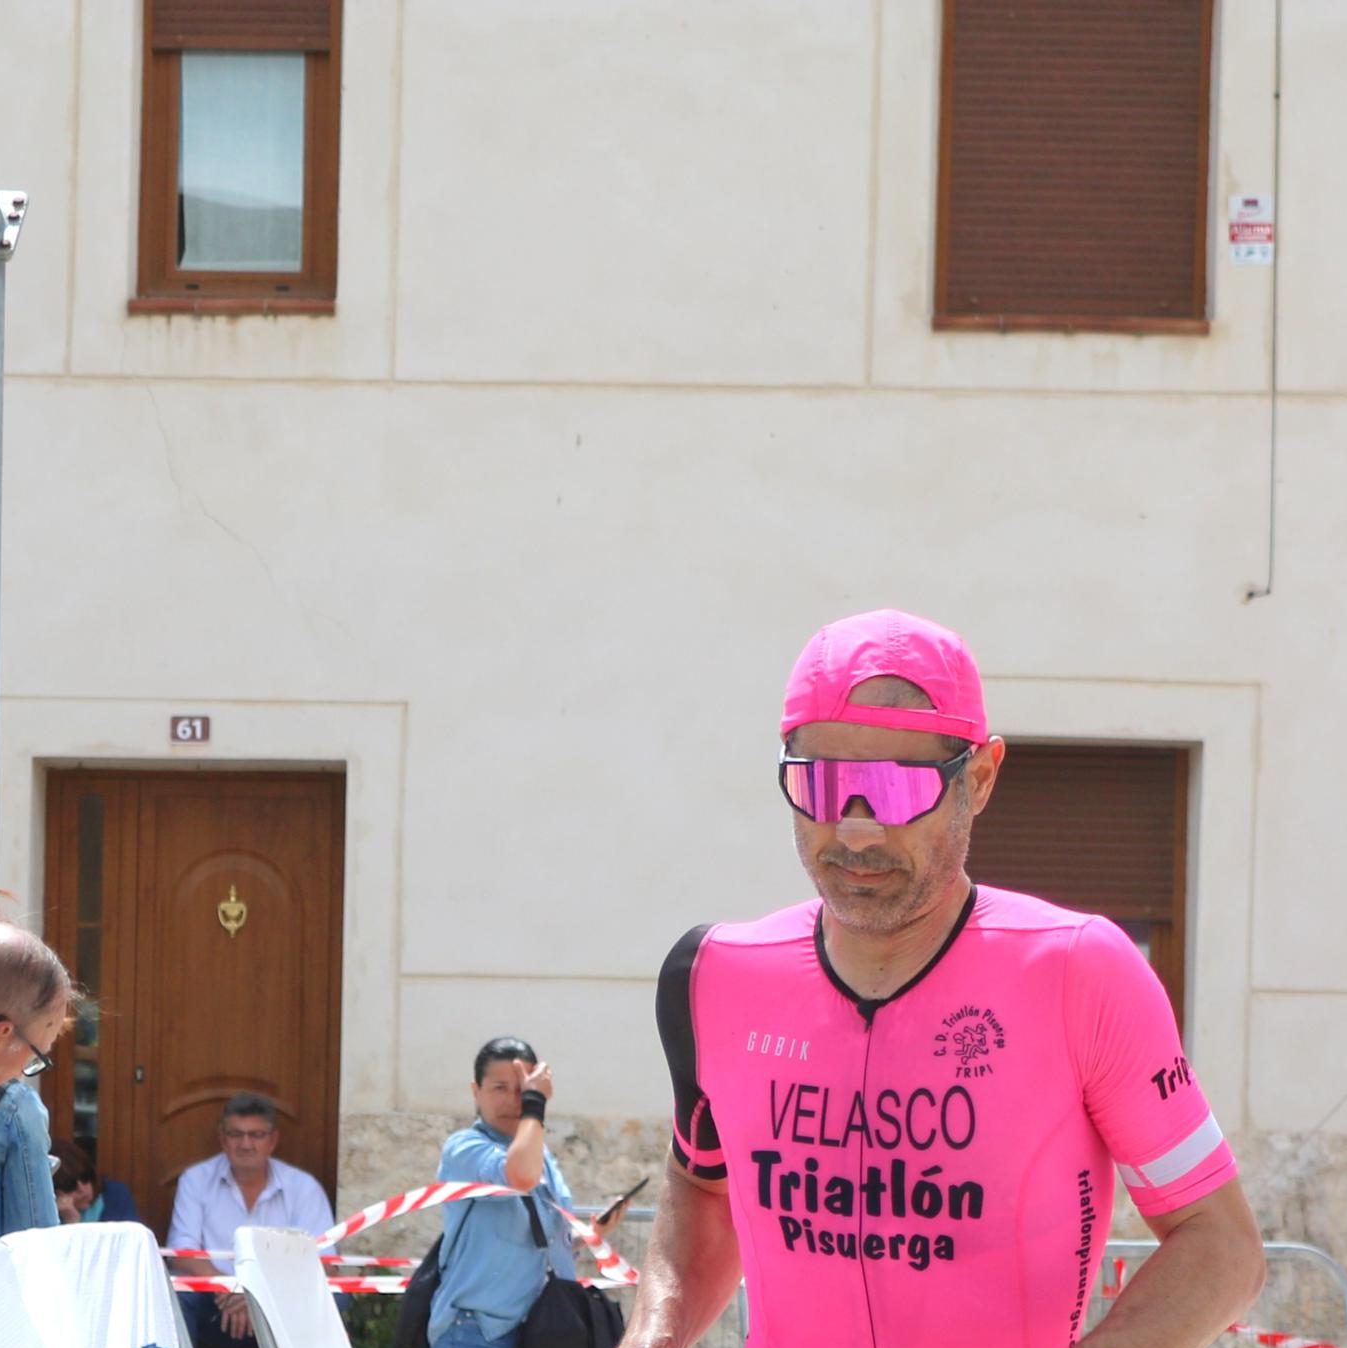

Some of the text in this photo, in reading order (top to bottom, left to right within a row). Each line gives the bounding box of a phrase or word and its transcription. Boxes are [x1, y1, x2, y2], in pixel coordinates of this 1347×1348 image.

[177, 719, 202, 740] 61
[747, 1031, 810, 1061] GOBIK
[770, 1080, 976, 1151] VELASCO
[751, 1150, 985, 1220] Triatlón
[779, 1216, 955, 1271] Pisuerga
